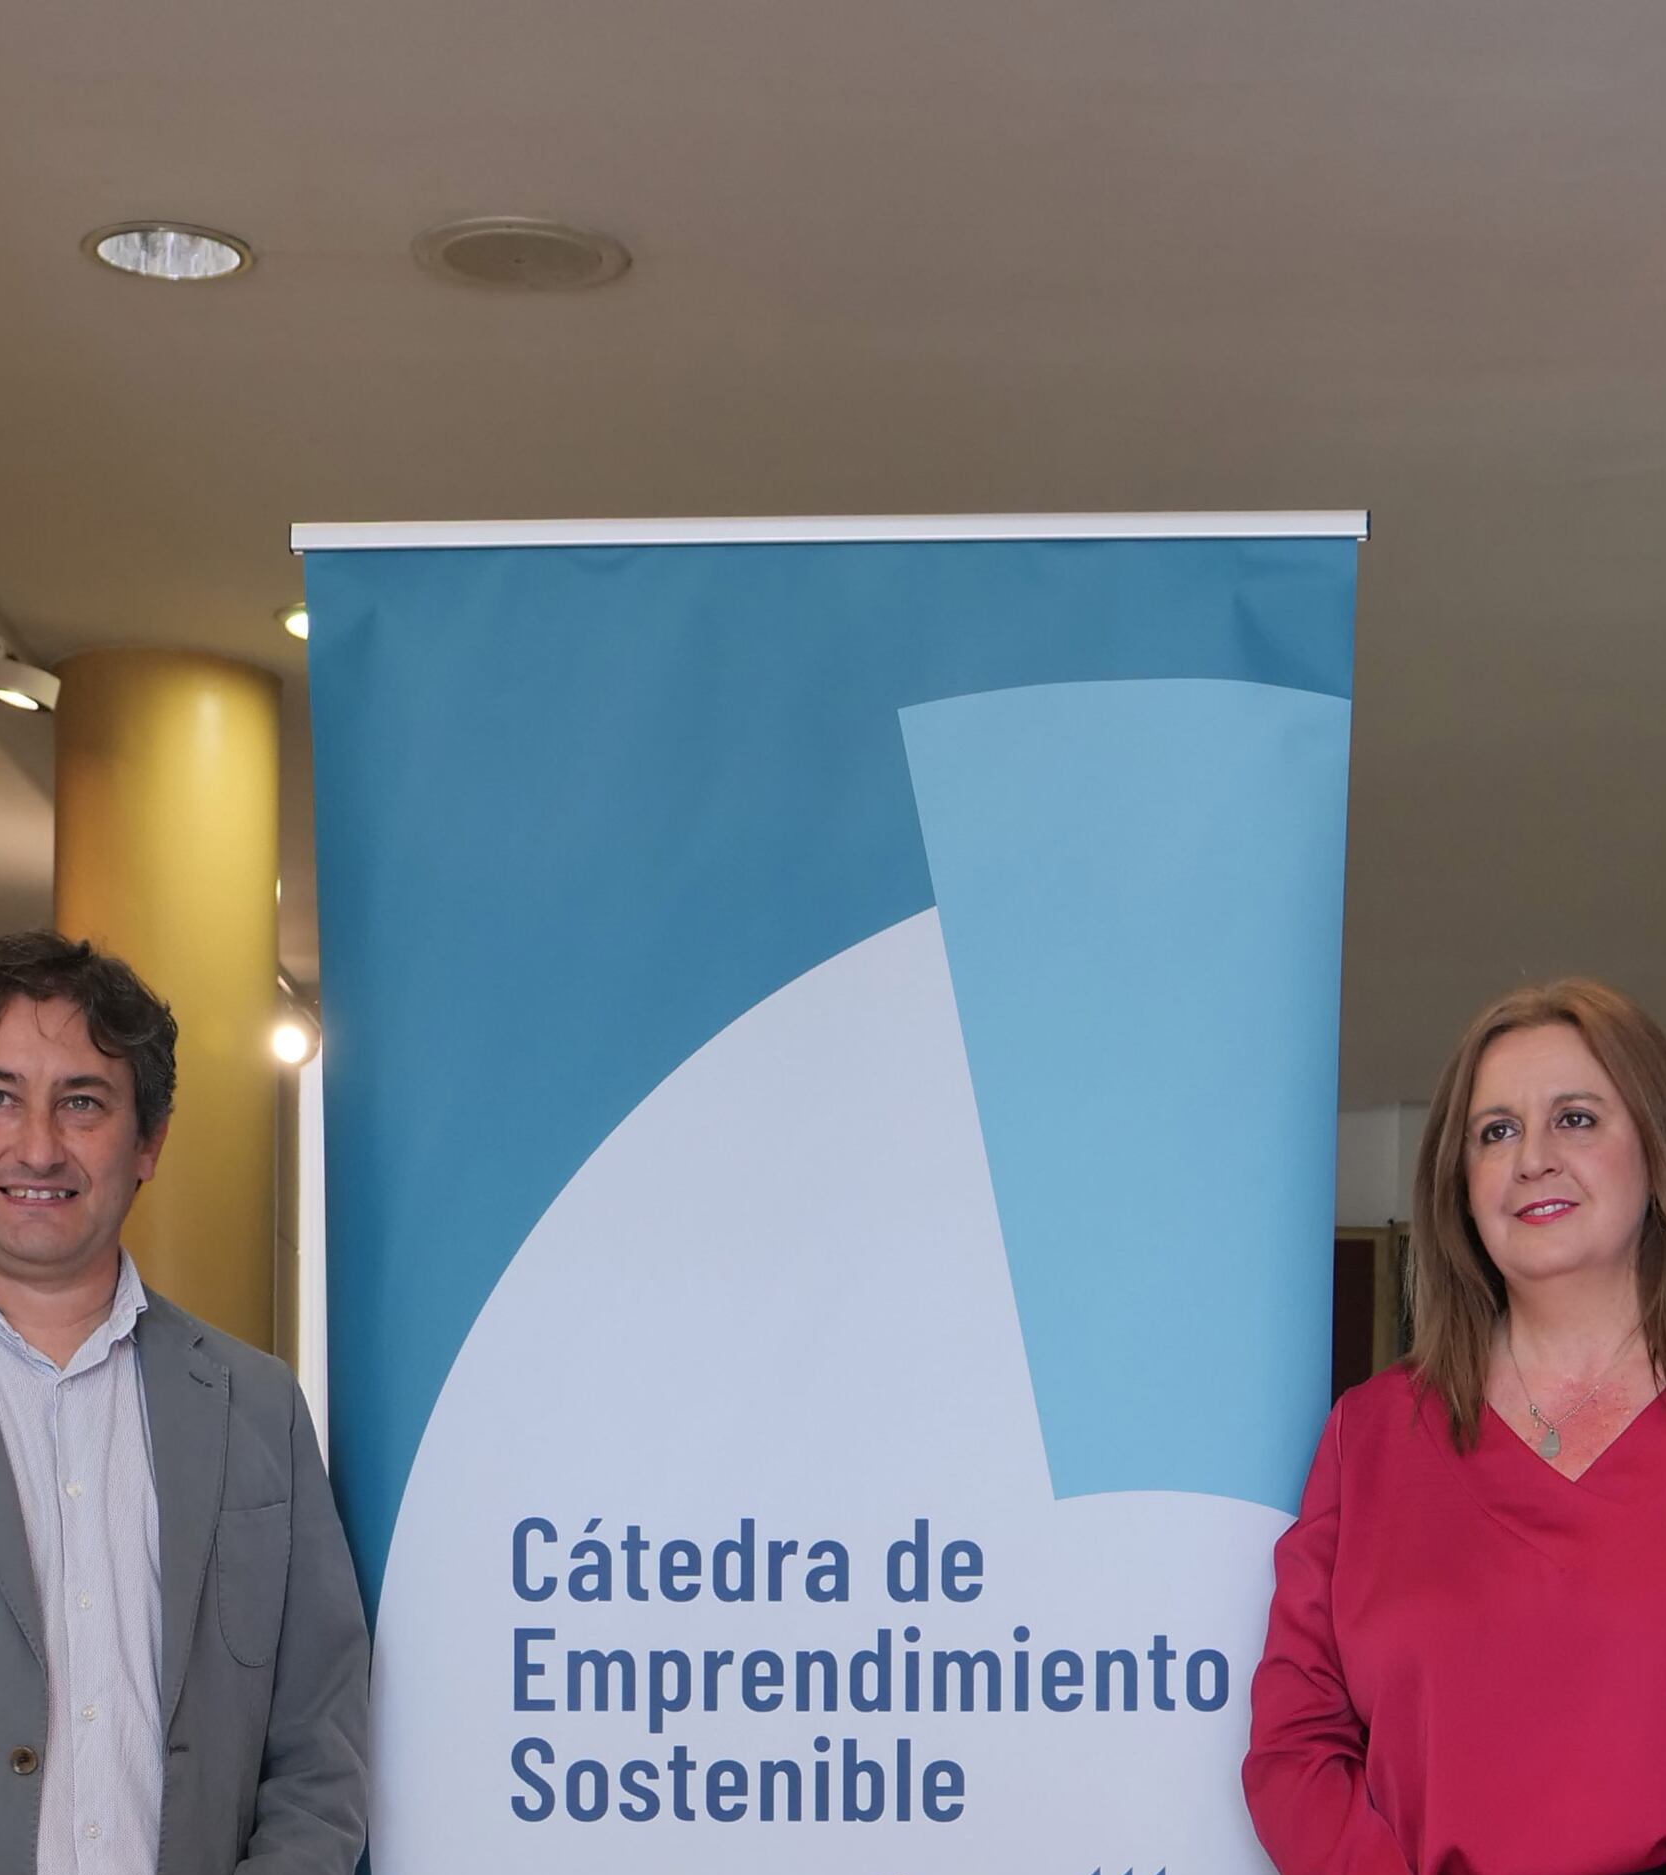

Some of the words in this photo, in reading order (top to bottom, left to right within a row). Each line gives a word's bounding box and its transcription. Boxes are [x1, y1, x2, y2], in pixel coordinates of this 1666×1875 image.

[512, 1517, 850, 1603] Cátedra
[886, 1518, 984, 1603] de
[513, 1625, 1229, 1734] Emprendimiento
[511, 1736, 965, 1823] Sostenible
